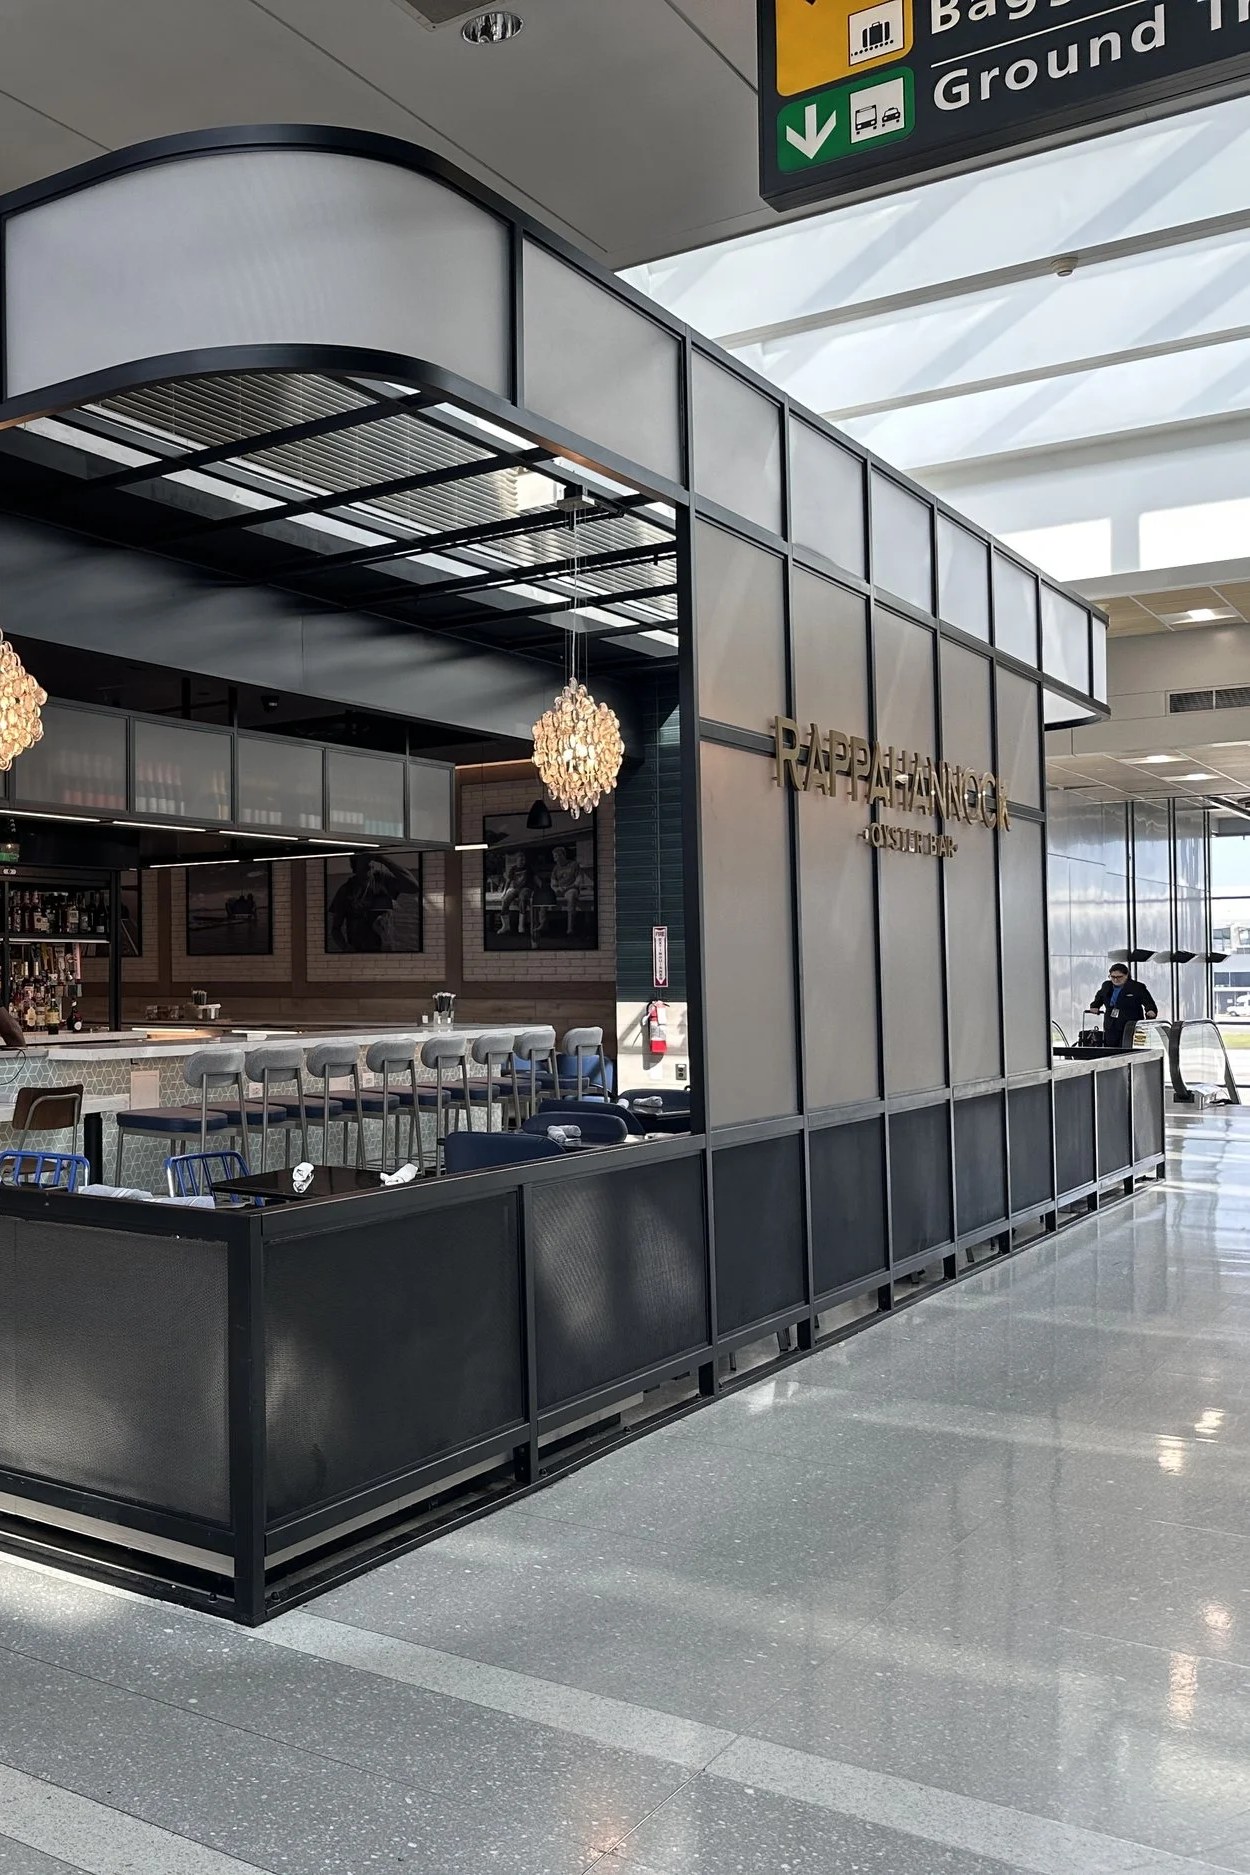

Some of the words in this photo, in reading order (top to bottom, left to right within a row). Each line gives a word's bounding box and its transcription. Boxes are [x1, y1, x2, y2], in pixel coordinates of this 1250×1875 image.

[931, 0, 1073, 34] Bag
[933, 3, 1165, 111] Ground
[774, 715, 1011, 832] RAPPAHANNOCK
[870, 823, 922, 853] OYSTER
[928, 833, 954, 858] BAR
